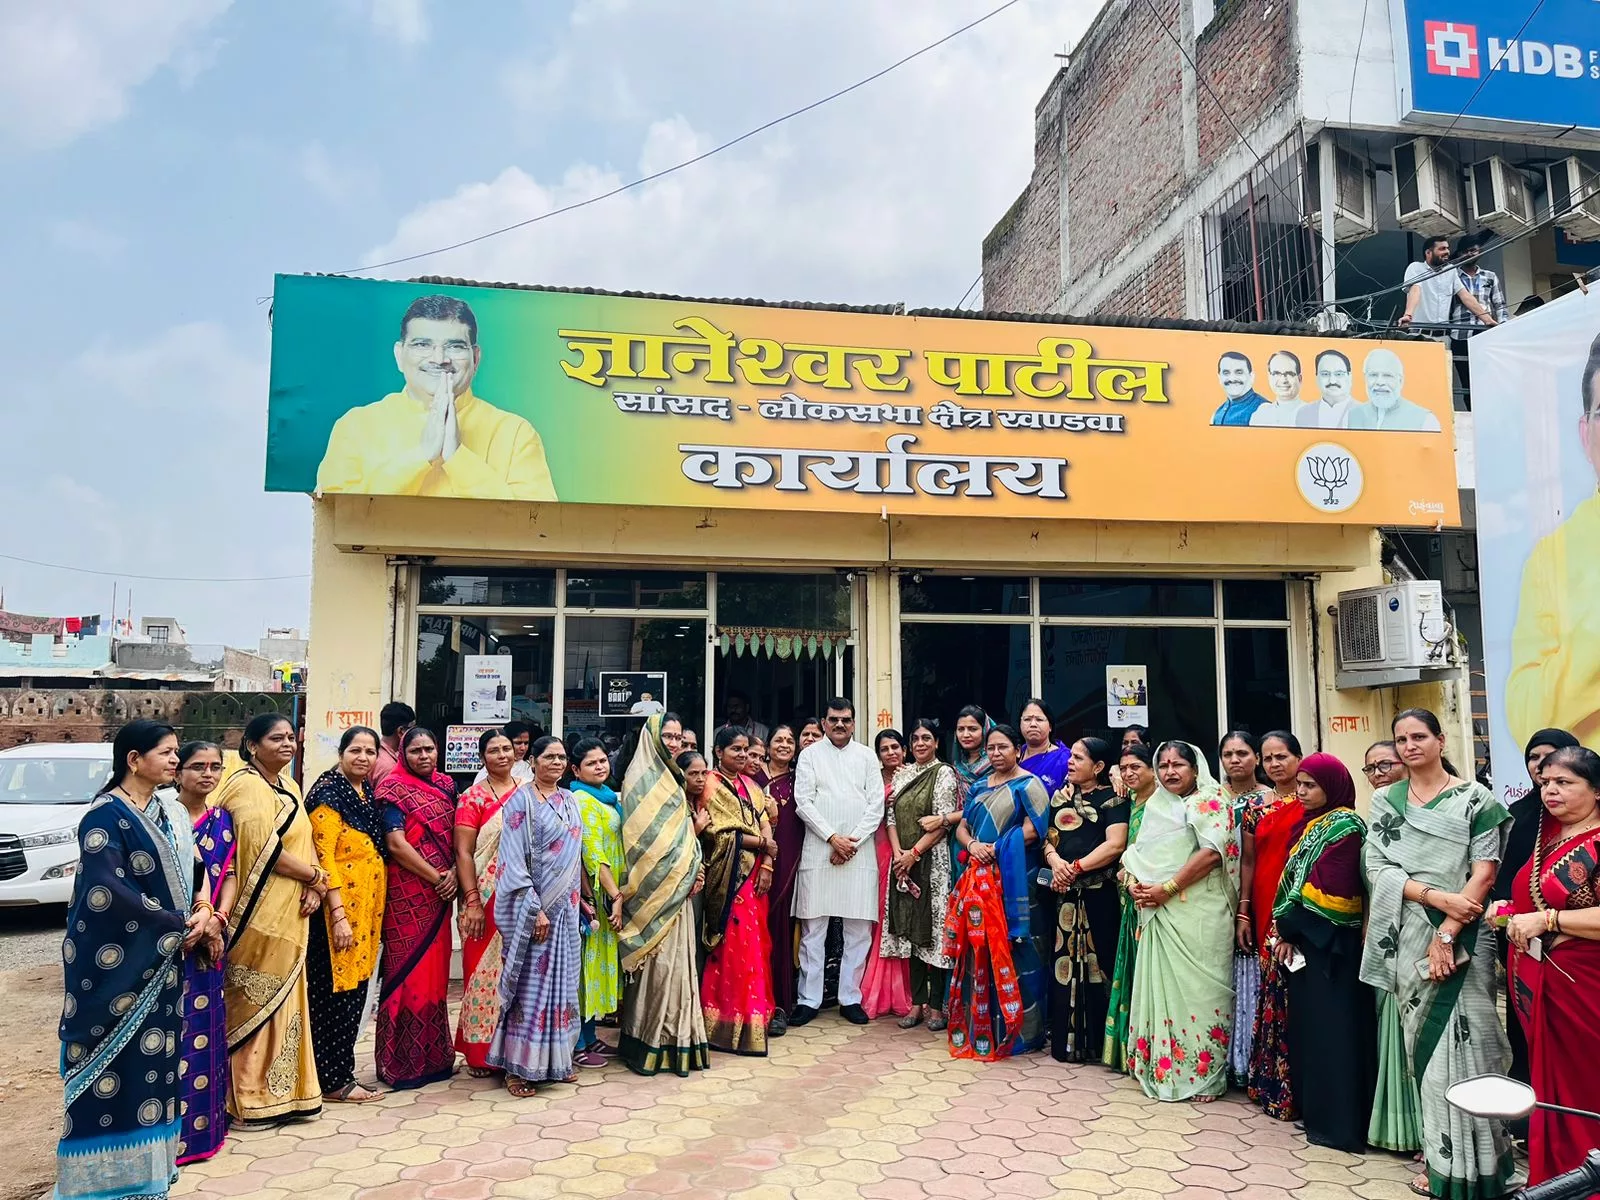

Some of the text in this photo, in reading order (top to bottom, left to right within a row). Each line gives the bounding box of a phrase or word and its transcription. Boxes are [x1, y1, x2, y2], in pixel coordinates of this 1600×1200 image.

[1487, 37, 1584, 79] HDB
[557, 316, 1170, 403] ज्ञानेश्वर पाटील
[612, 386, 732, 421] सांसद
[757, 392, 923, 425] लोकसभा
[927, 400, 994, 430] क्षेत्र
[996, 409, 1126, 433] खण्डवा
[677, 433, 1068, 499] कार्यालय
